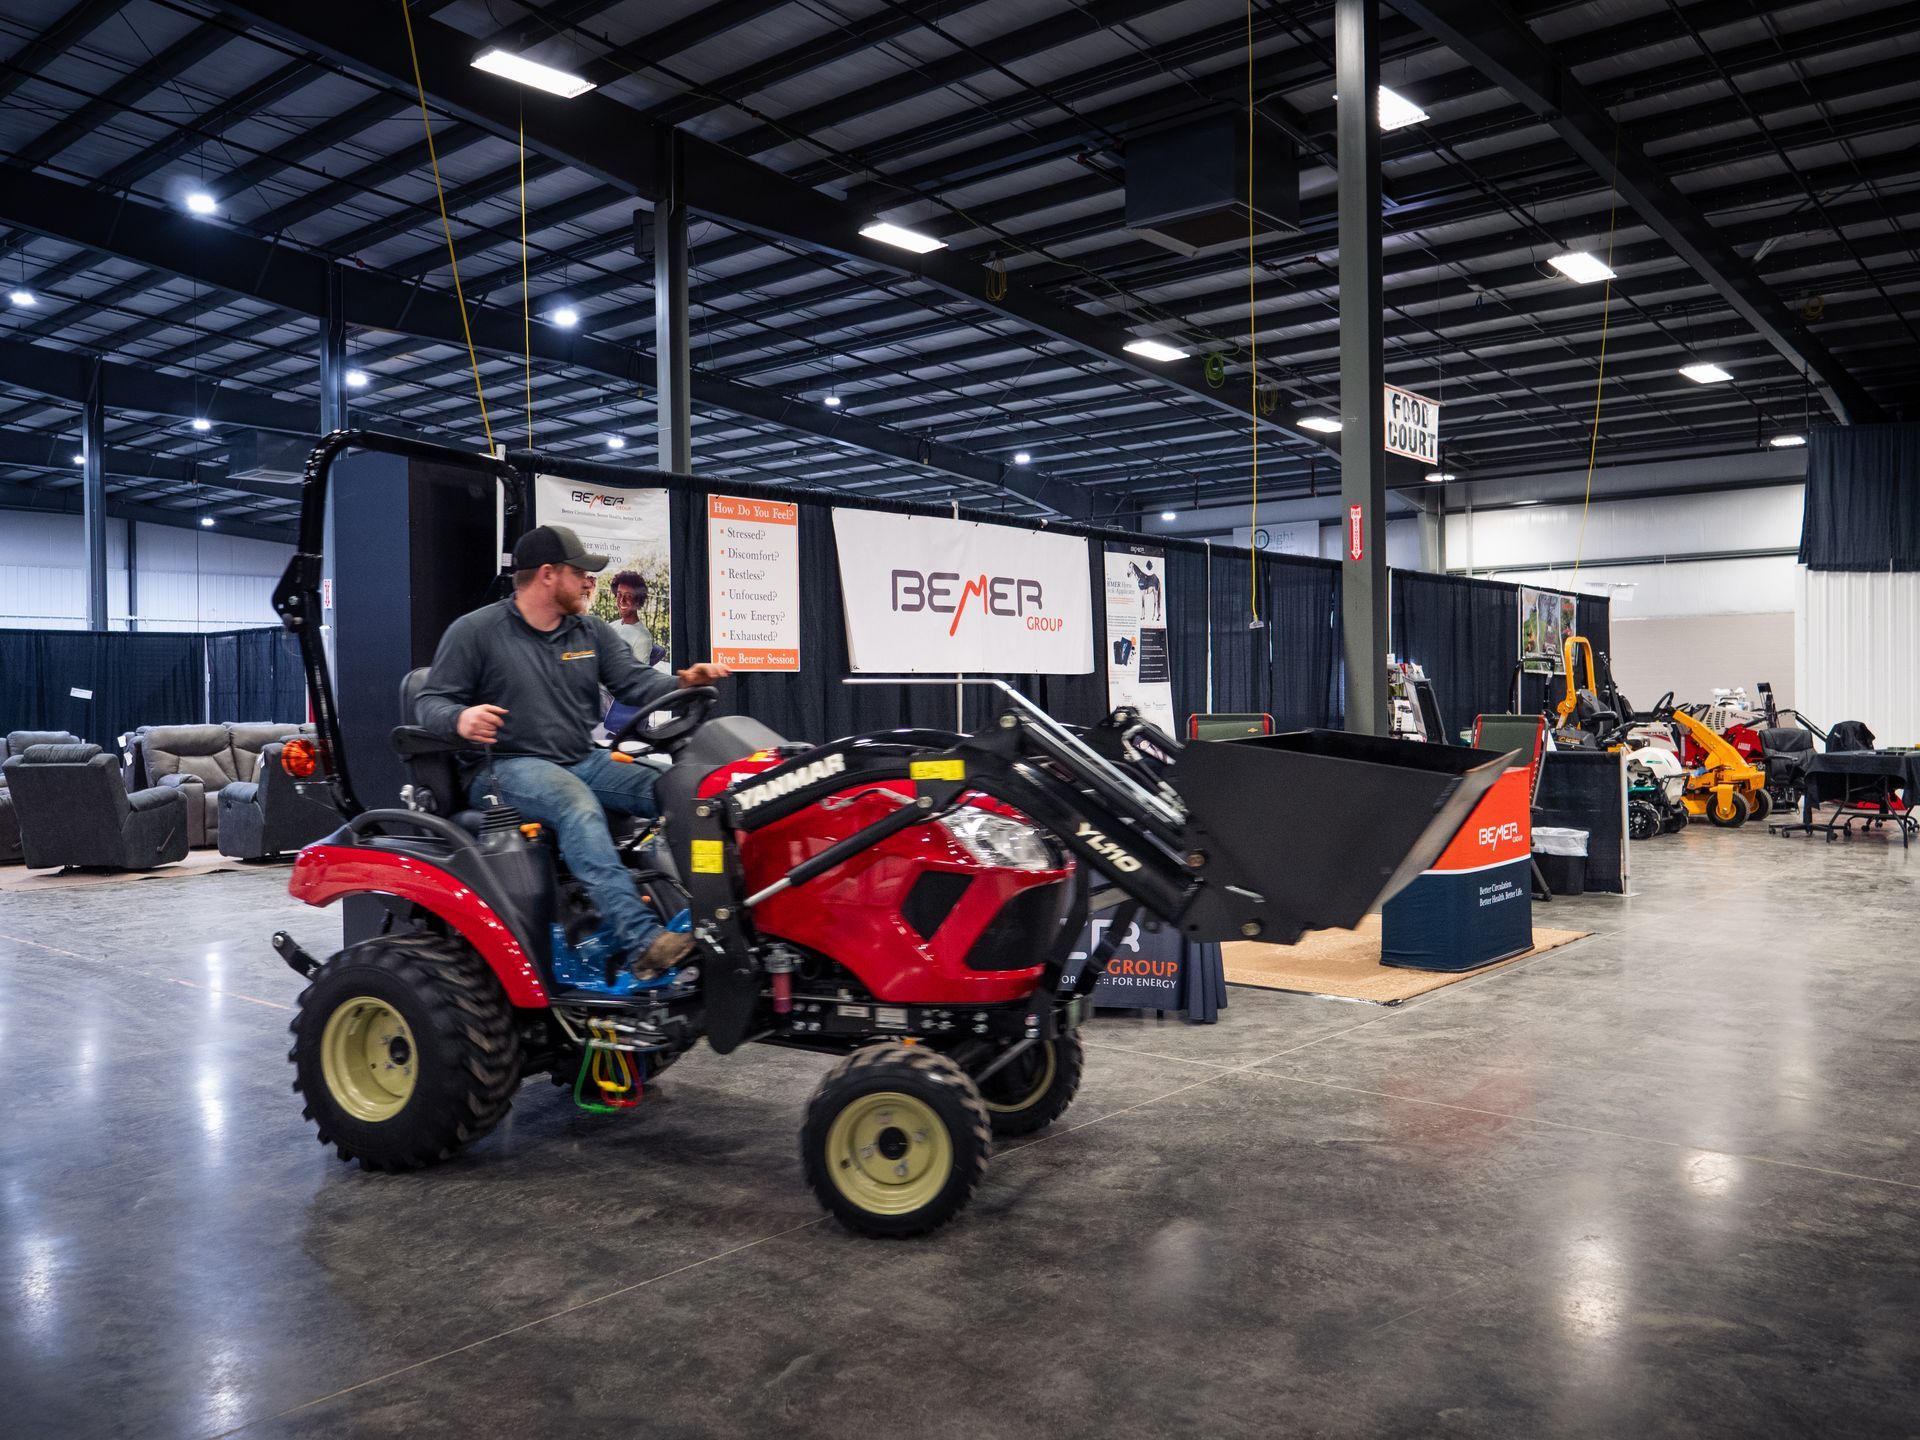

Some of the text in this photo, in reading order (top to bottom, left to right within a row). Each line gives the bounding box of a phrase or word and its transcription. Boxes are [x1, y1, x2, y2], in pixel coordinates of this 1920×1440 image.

[1392, 393, 1429, 428] FOOD
[1388, 421, 1436, 458] COURT
[571, 490, 625, 509] BEMER
[713, 502, 794, 520] How Do You Feel?
[727, 526, 766, 540] Stressed?
[610, 543, 621, 551] the
[728, 547, 779, 561] Discomfort?
[728, 568, 765, 581] Restless?
[729, 588, 778, 602] Unfocused?
[891, 569, 1063, 637] BEMER GROUP
[729, 609, 786, 625] Low Energy?
[730, 629, 778, 641] Exhausted?
[717, 652, 795, 665] Free Bemer Session
[733, 753, 846, 810] YANMAR
[1478, 822, 1518, 851] BEMER
[1106, 959, 1179, 978] GROUP
[1112, 976, 1134, 986] FOR
[1136, 978, 1177, 989] ENERGY
